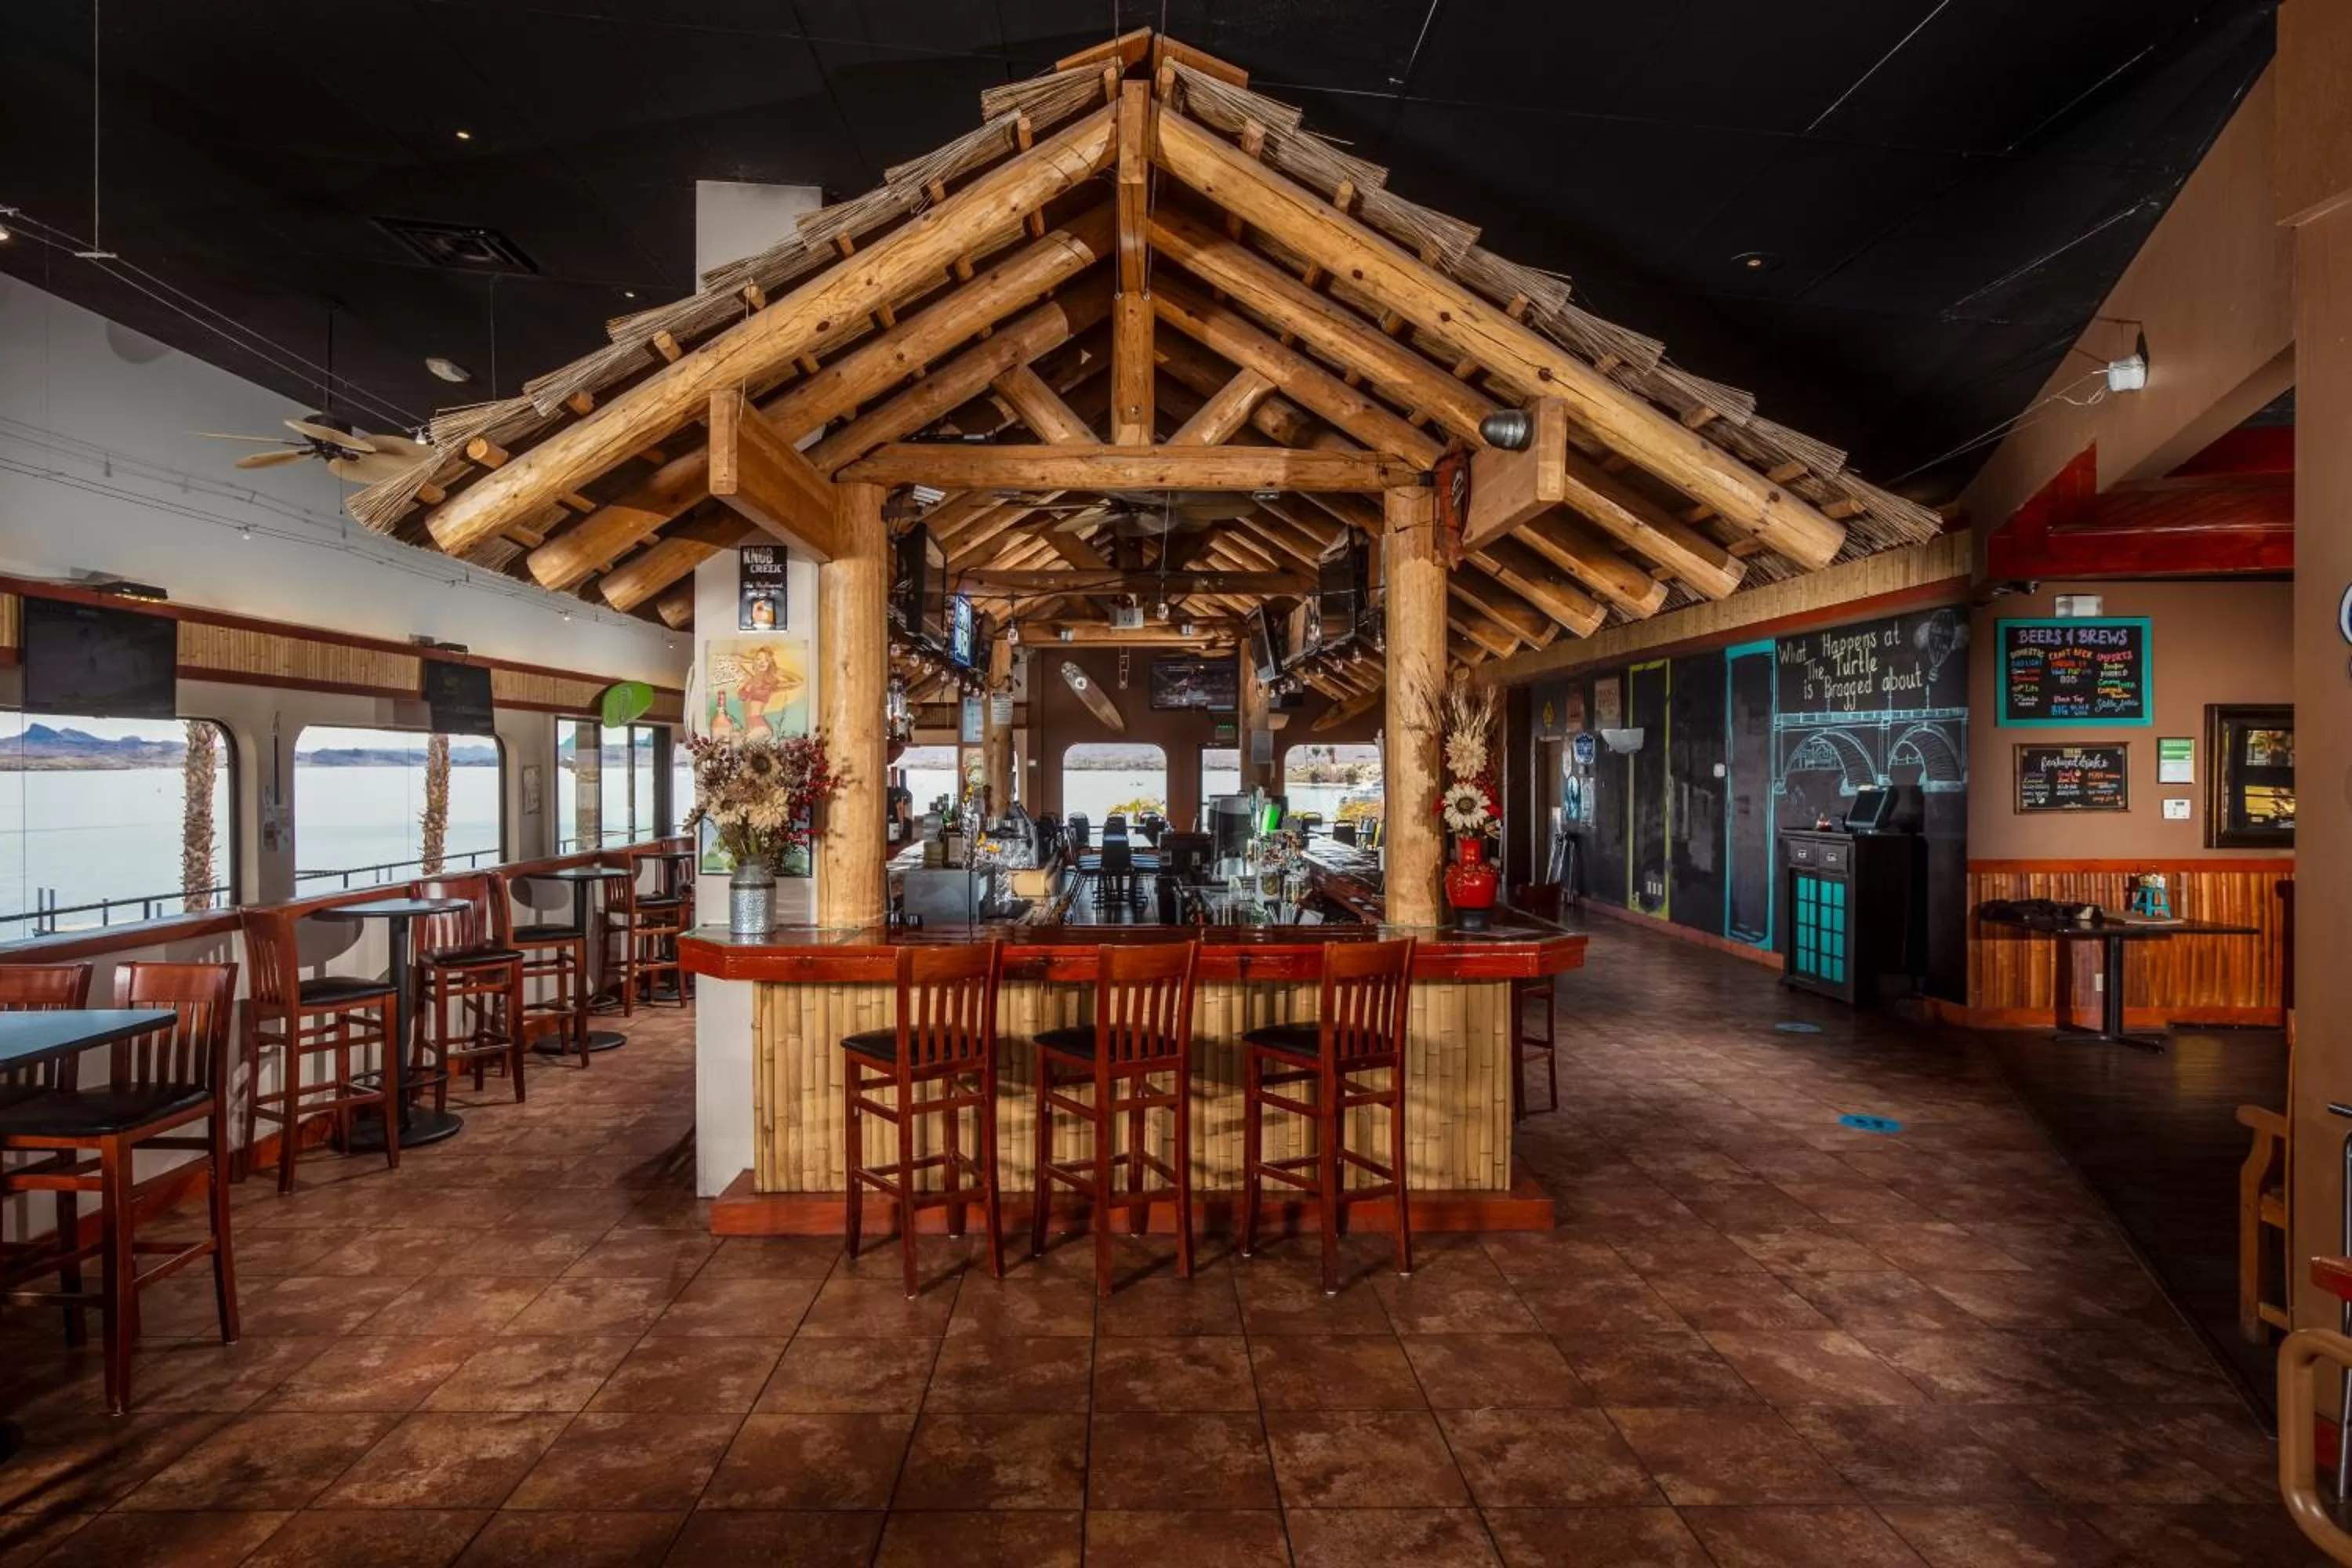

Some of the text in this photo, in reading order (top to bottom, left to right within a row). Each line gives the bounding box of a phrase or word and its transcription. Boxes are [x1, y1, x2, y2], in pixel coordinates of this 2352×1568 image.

[742, 547, 774, 564] KNOB
[750, 564, 783, 573] CREEK
[1778, 621, 1901, 665] What Happens at
[2018, 629, 2062, 645] BEERS
[2078, 628, 2128, 645] BREWS
[1803, 648, 1878, 681] The Turtle
[1804, 662, 1923, 711] is Bragged about
